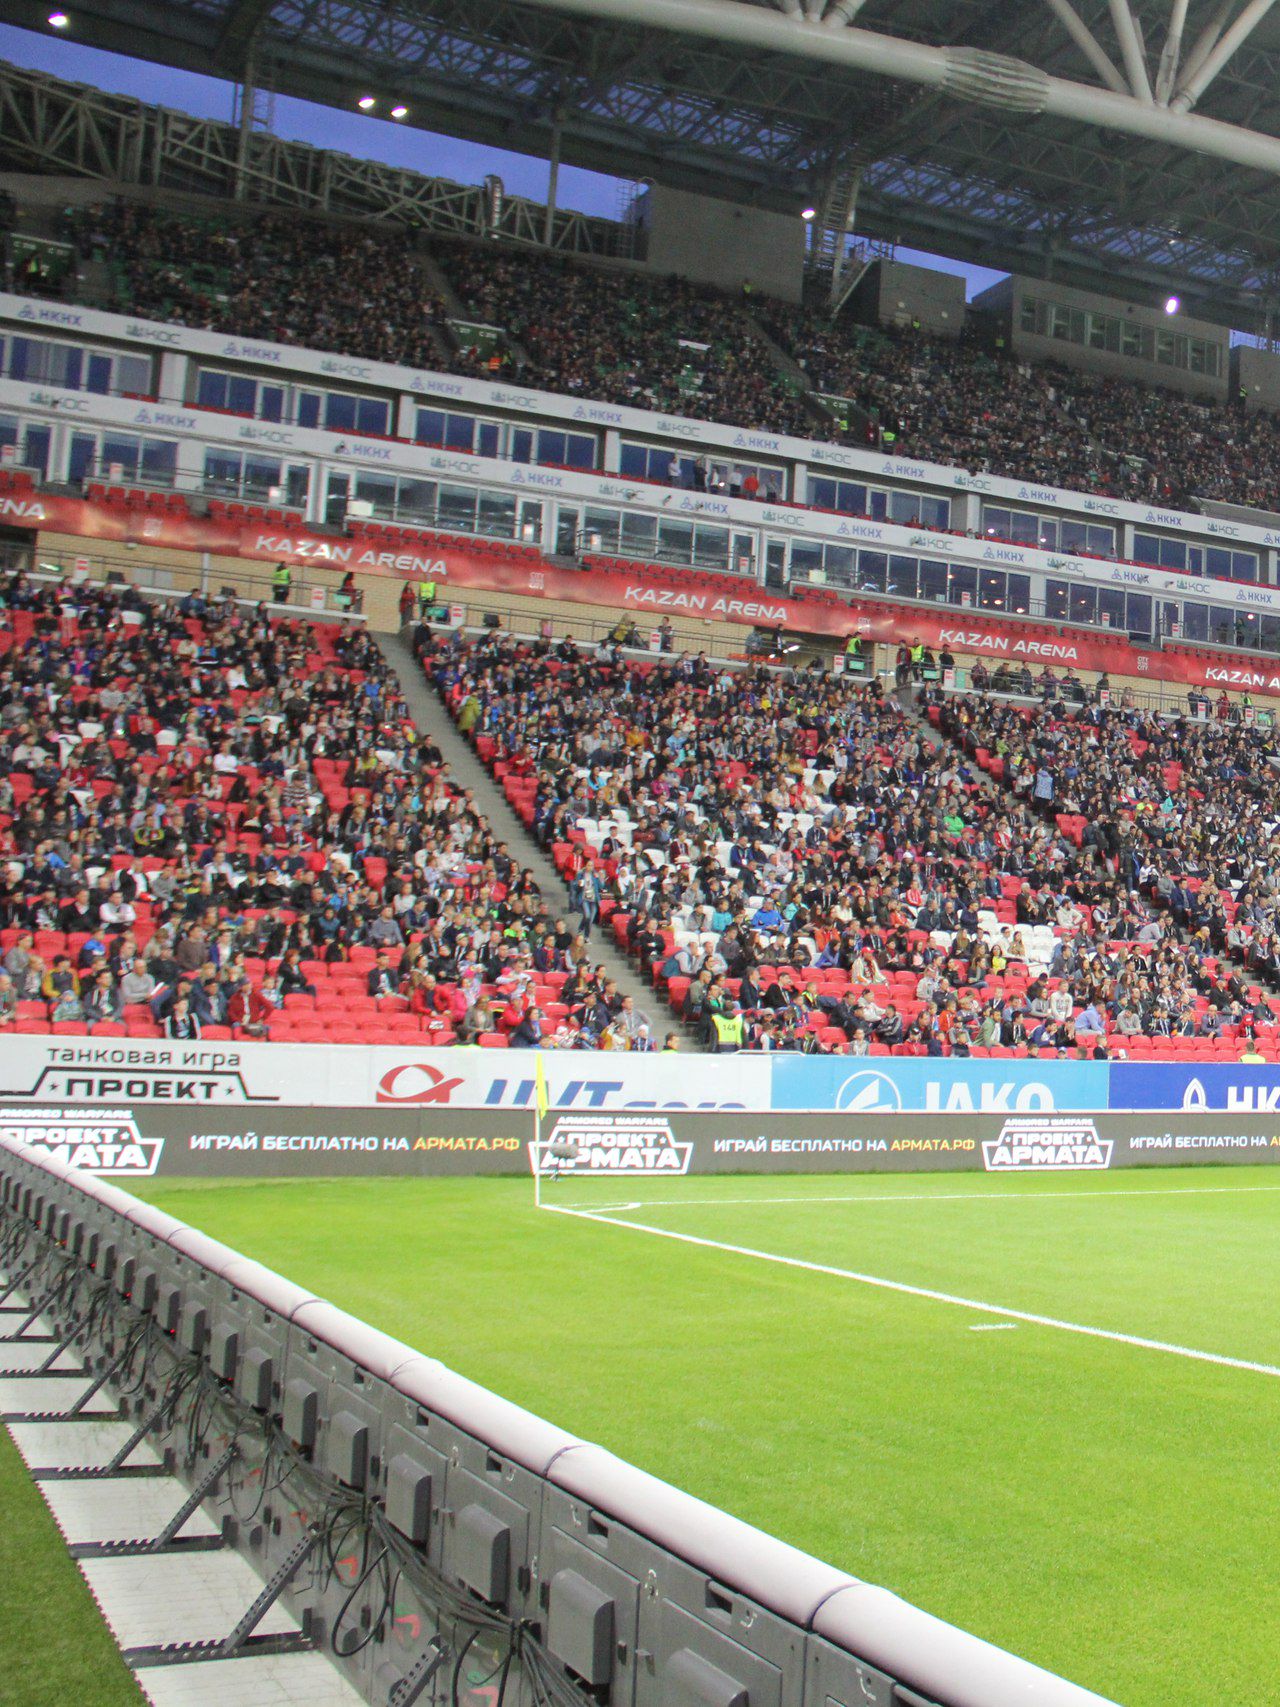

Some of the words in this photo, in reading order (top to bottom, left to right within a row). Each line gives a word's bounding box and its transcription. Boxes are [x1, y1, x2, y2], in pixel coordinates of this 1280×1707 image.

[39, 308, 81, 326] НКНХ
[242, 346, 281, 361] НКНХ
[427, 381, 463, 397] НКНХ
[589, 410, 622, 425] НКНХ
[749, 437, 780, 452] НКНХ
[896, 464, 925, 478] НКНХ
[1031, 490, 1057, 503] НКНХ
[1157, 514, 1182, 527] НКНХ
[0, 500, 45, 520] NA
[153, 412, 195, 428] НКНХ
[353, 444, 391, 461] НКНХ
[529, 472, 562, 488] НКНХ
[853, 525, 882, 540] НКНХ
[997, 549, 1024, 563] НКНХ
[1248, 592, 1271, 604] НКНХ
[256, 536, 353, 561] KAZAN
[359, 550, 448, 576] ARENA
[625, 587, 705, 610] KAZAN
[711, 599, 787, 621] ARENA
[939, 629, 1008, 650] KAZAN
[1013, 640, 1077, 660] ARENA
[1205, 667, 1265, 687] KAZAN
[47, 1046, 171, 1065] танковая
[182, 1050, 241, 1070] игра
[66, 1078, 219, 1099] ПРОЕКТ
[189, 1132, 257, 1150] ИГРАЙ
[262, 1135, 379, 1151] БЕСПЛАТНО
[383, 1137, 410, 1151] НА
[413, 1137, 520, 1152] АРМАТА.РФ
[568, 1133, 658, 1147] ПРОЕКТ
[714, 1136, 767, 1152] ИГРАЙ
[771, 1139, 862, 1152] БЕСПЛАТНО
[867, 1139, 887, 1151] НА
[891, 1139, 975, 1151] АРМАТА.РФ
[1012, 1133, 1085, 1146] ПРОЕКТ
[1130, 1134, 1172, 1148] ИГРАЙ
[1175, 1136, 1248, 1148] БЕСПЛАТНО
[1251, 1136, 1267, 1146] НА
[992, 1146, 1103, 1165] АРМАТА
